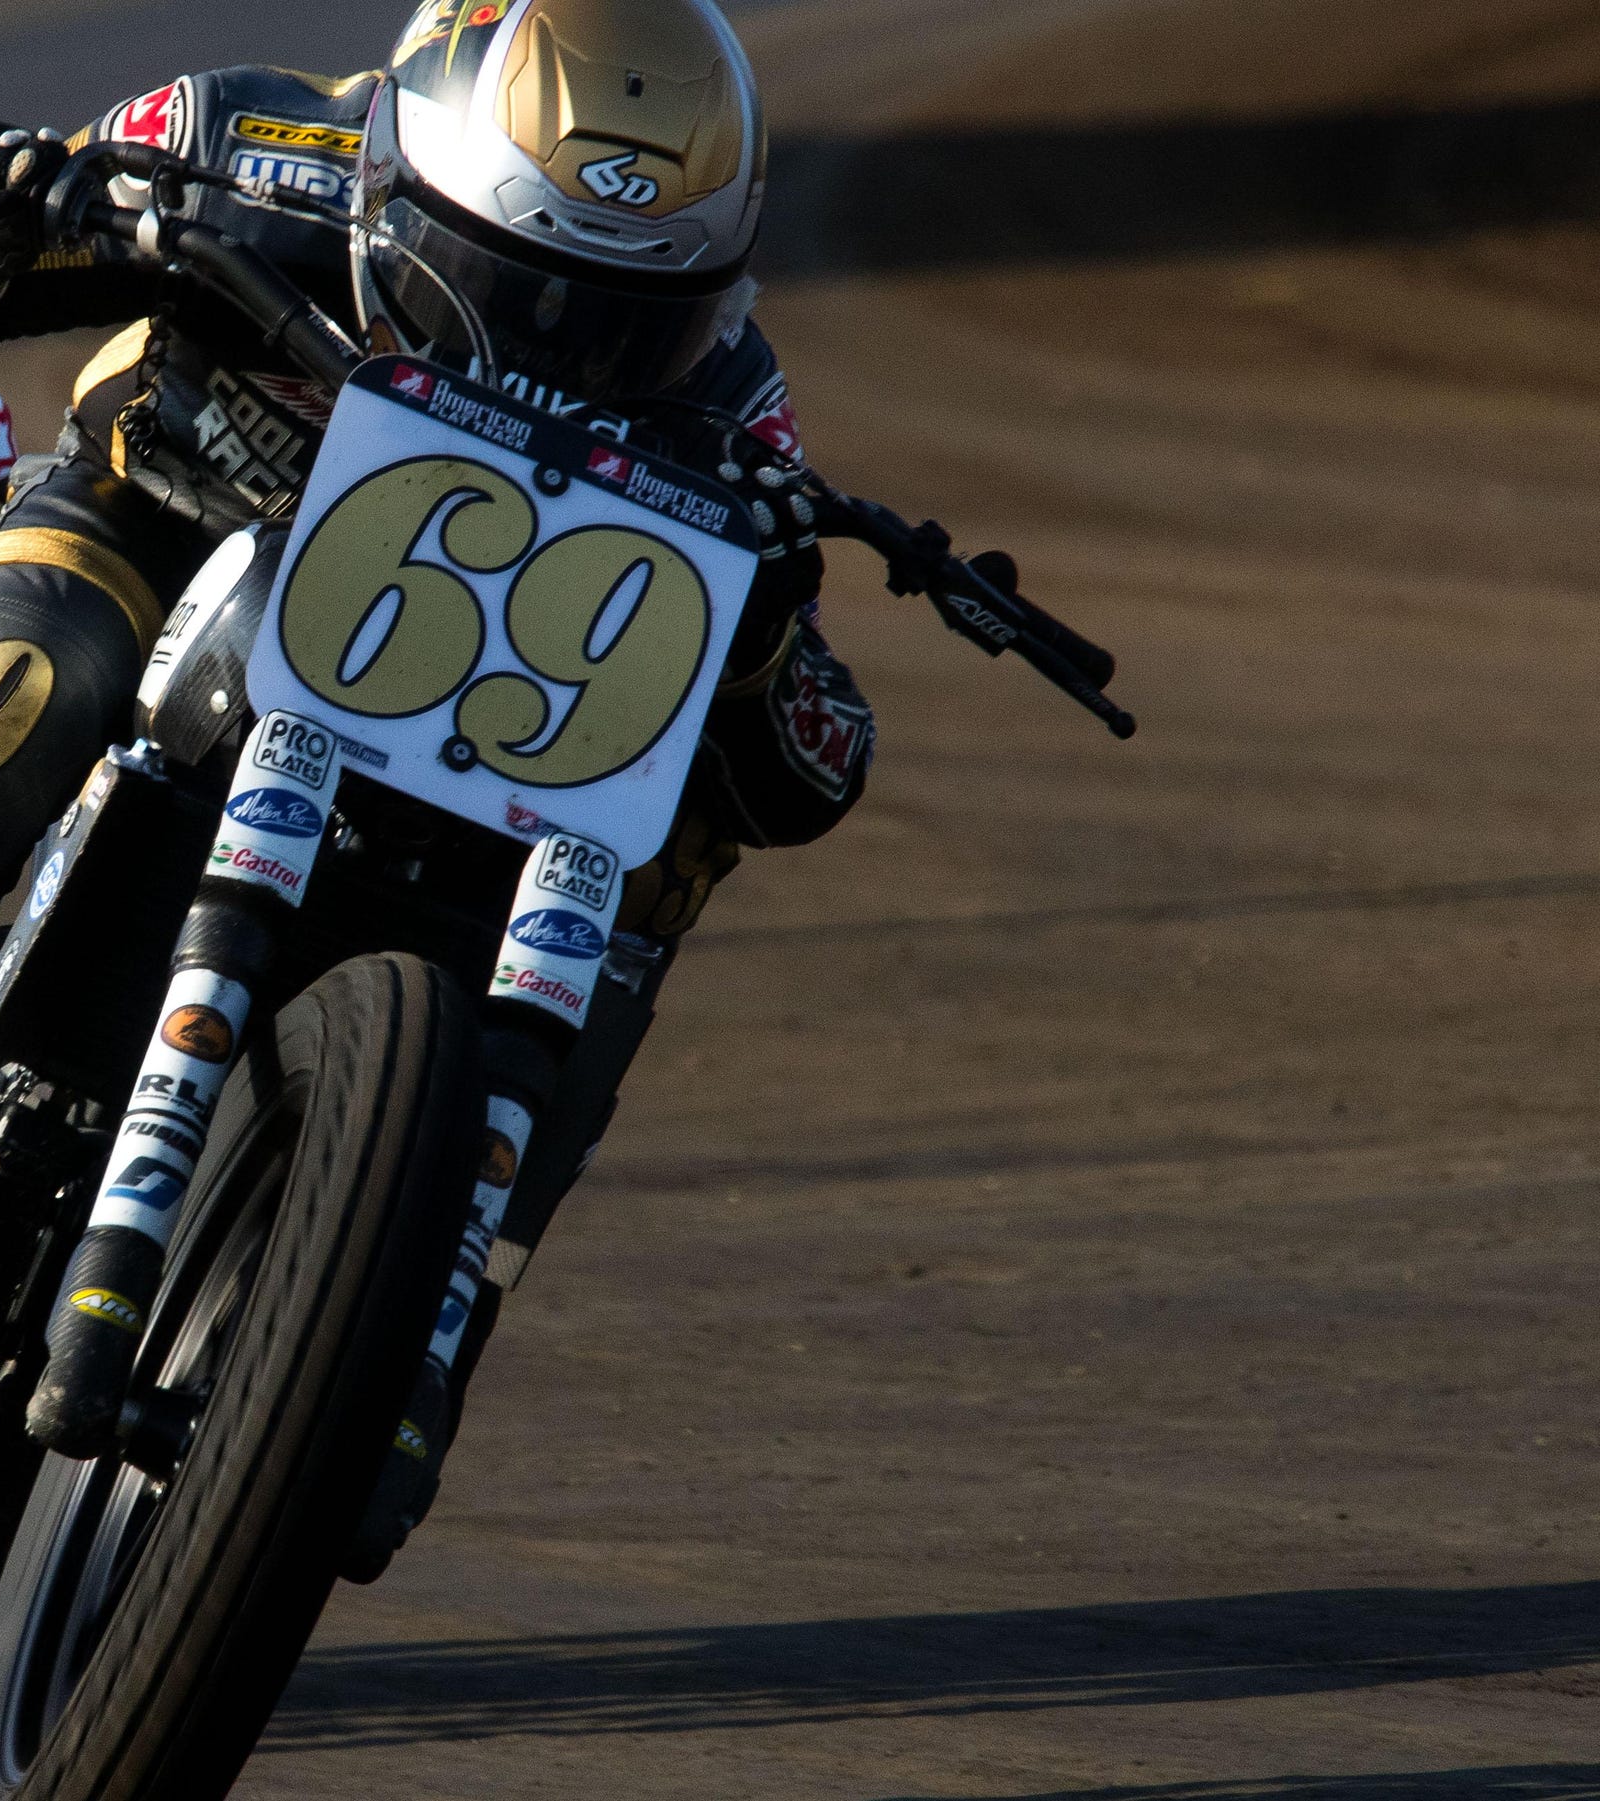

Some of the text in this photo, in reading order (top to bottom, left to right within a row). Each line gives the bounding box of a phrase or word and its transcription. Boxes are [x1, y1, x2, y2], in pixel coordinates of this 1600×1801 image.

[578, 151, 658, 207] 6D
[431, 378, 535, 442] American
[632, 462, 730, 524] American
[278, 453, 711, 789] 69
[269, 719, 328, 760] PRO
[261, 748, 323, 784] PLATES
[234, 848, 303, 891] Castrol
[550, 840, 610, 881] PRO
[544, 869, 604, 906] PLATES
[517, 969, 585, 1013] Castrol
